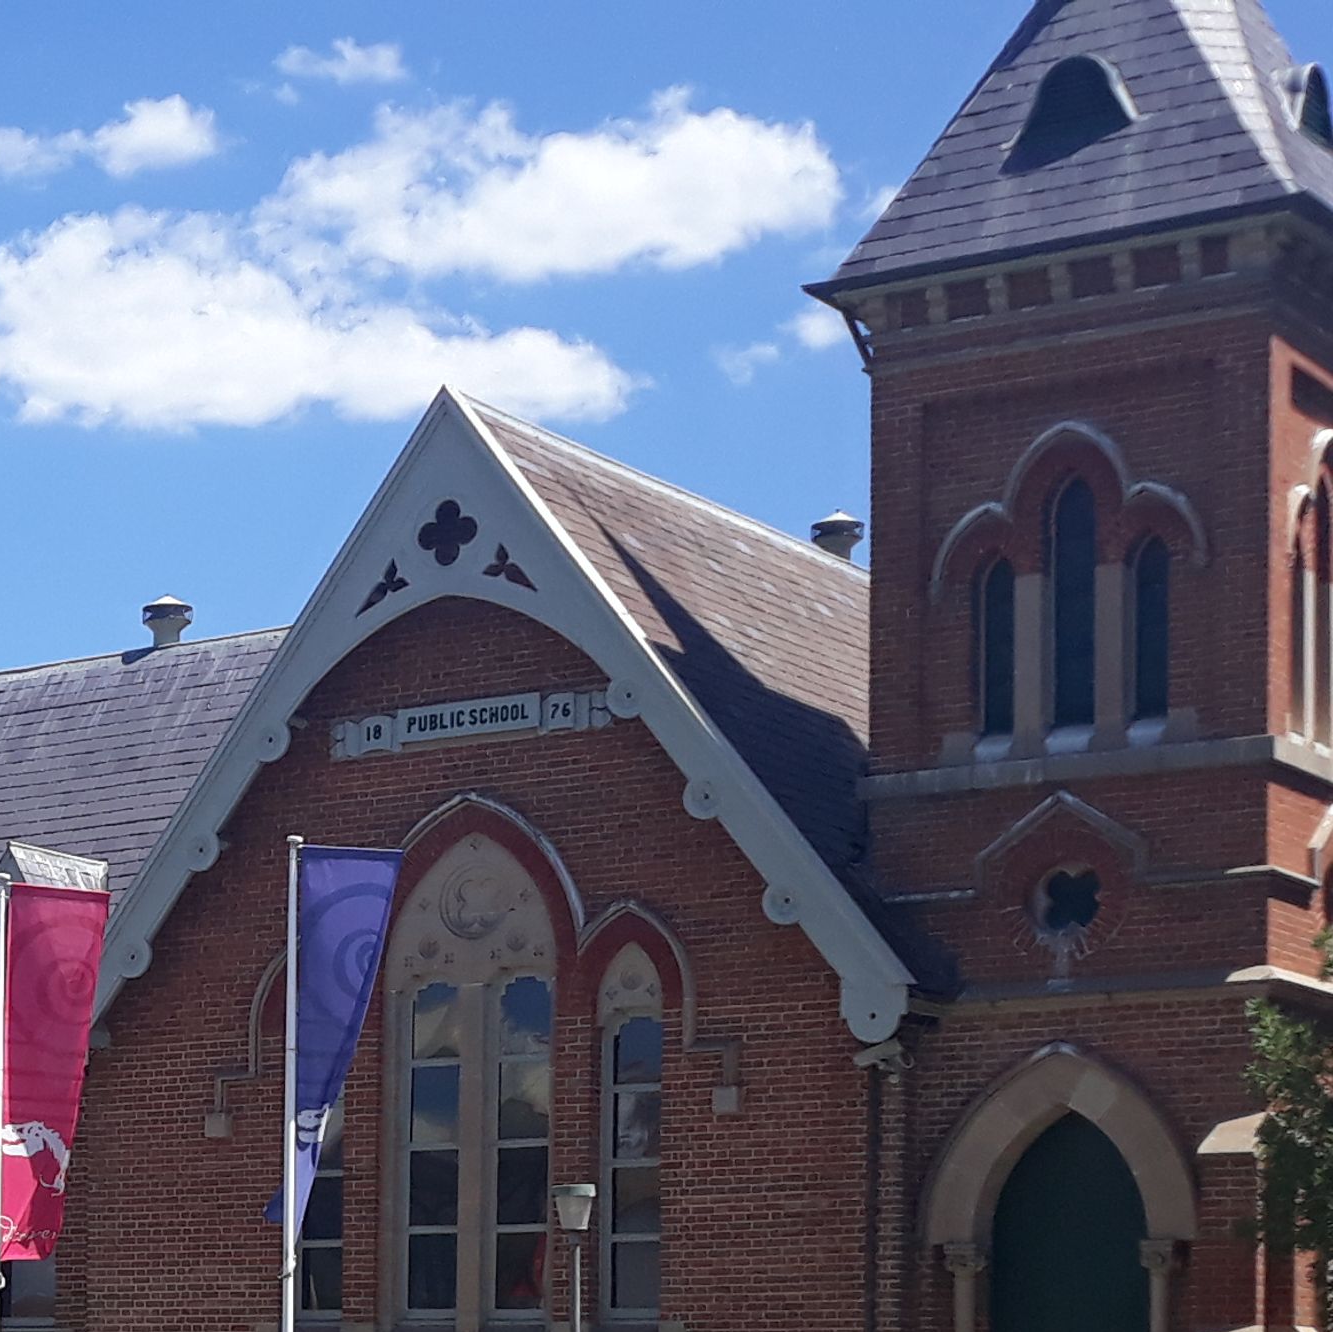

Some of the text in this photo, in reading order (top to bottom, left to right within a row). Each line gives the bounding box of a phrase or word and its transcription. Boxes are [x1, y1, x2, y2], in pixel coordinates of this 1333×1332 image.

[365, 702, 571, 741] 18 PUBLIC SCHOOL 76
